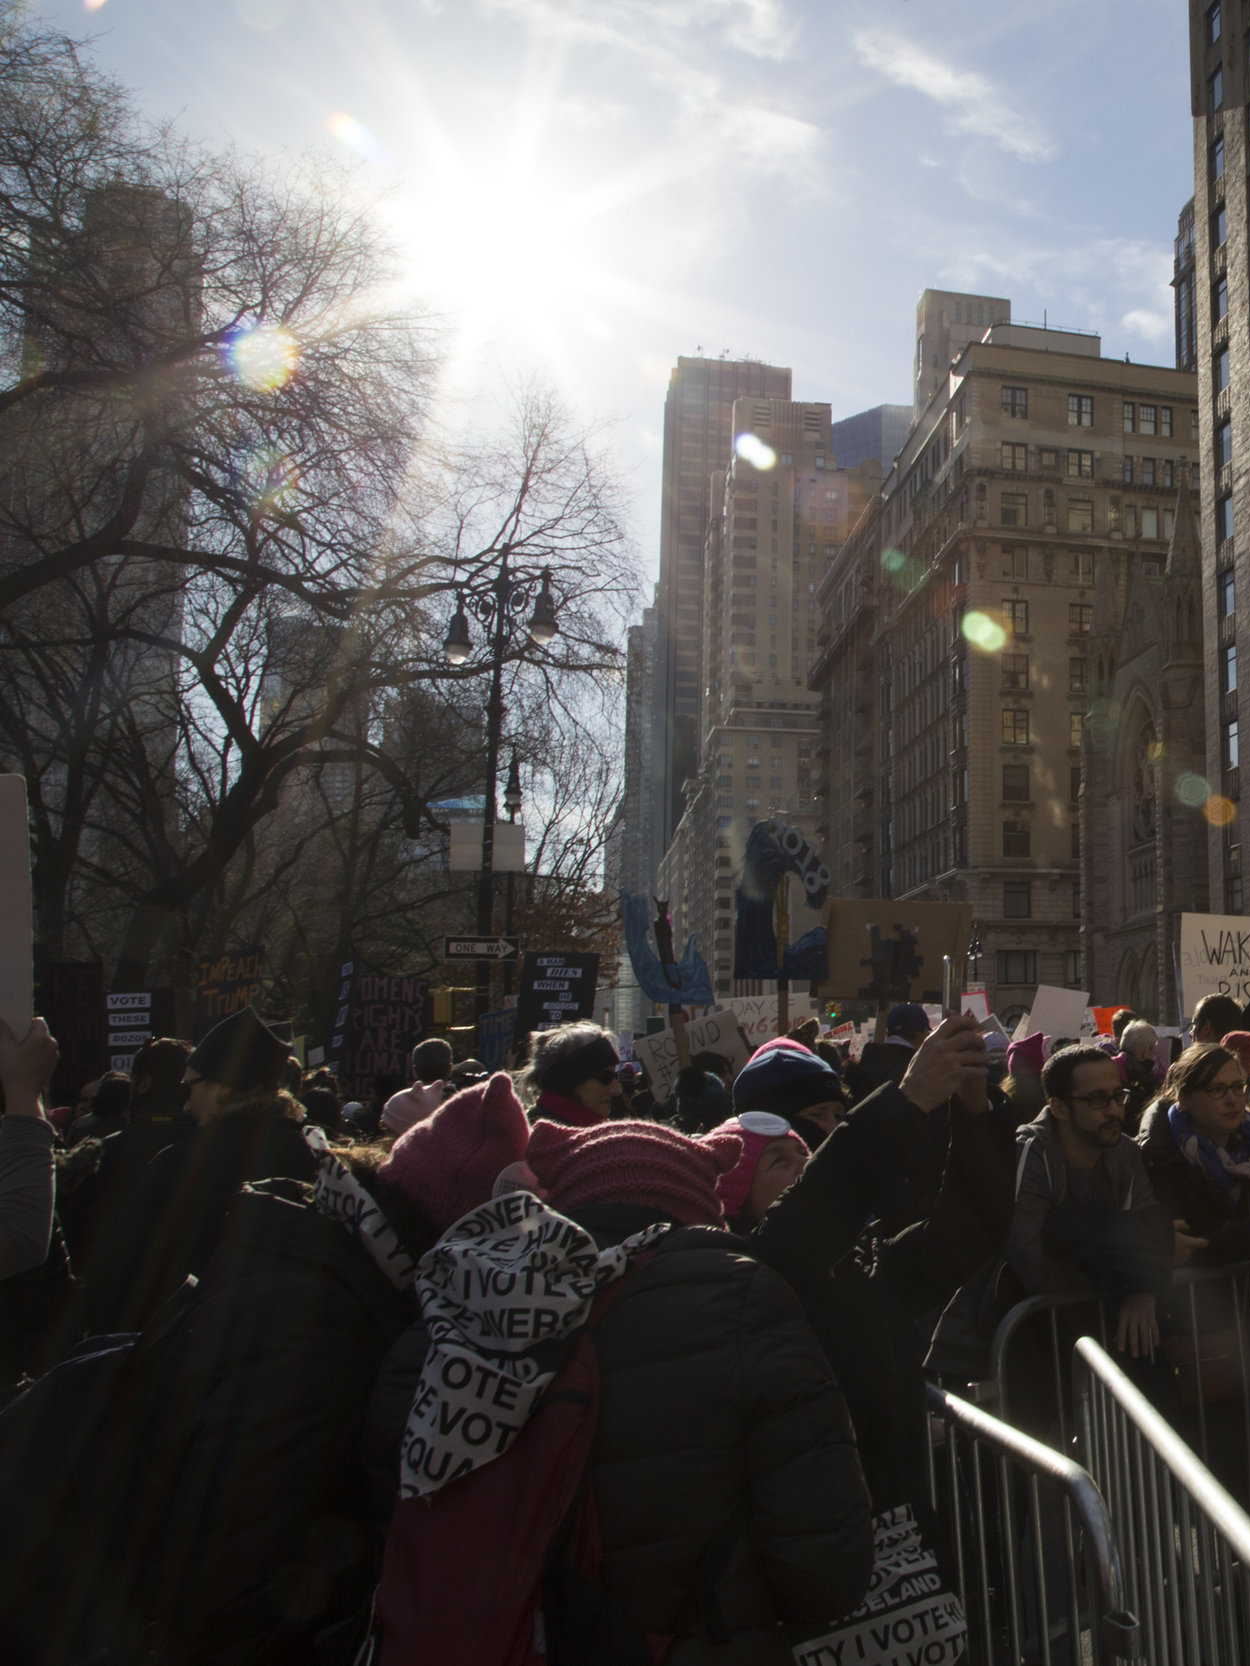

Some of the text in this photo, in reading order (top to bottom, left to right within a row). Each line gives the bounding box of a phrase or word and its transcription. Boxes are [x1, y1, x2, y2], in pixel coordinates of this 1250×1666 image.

[455, 944, 509, 953] ONE WAY
[109, 996, 147, 1006] VOTE
[357, 976, 428, 1009] OMENS
[111, 1015, 147, 1023] THESE
[480, 1012, 513, 1037] TIME
[113, 1034, 148, 1042] BOZOS
[361, 1028, 404, 1053] ARE
[647, 1019, 721, 1062] ROND
[463, 1270, 472, 1299] I
[478, 1266, 567, 1298] VOTE
[430, 1351, 523, 1412] OTE
[438, 1401, 520, 1454] VOT
[855, 1635, 865, 1659] I
[871, 1606, 949, 1651] VOTE
